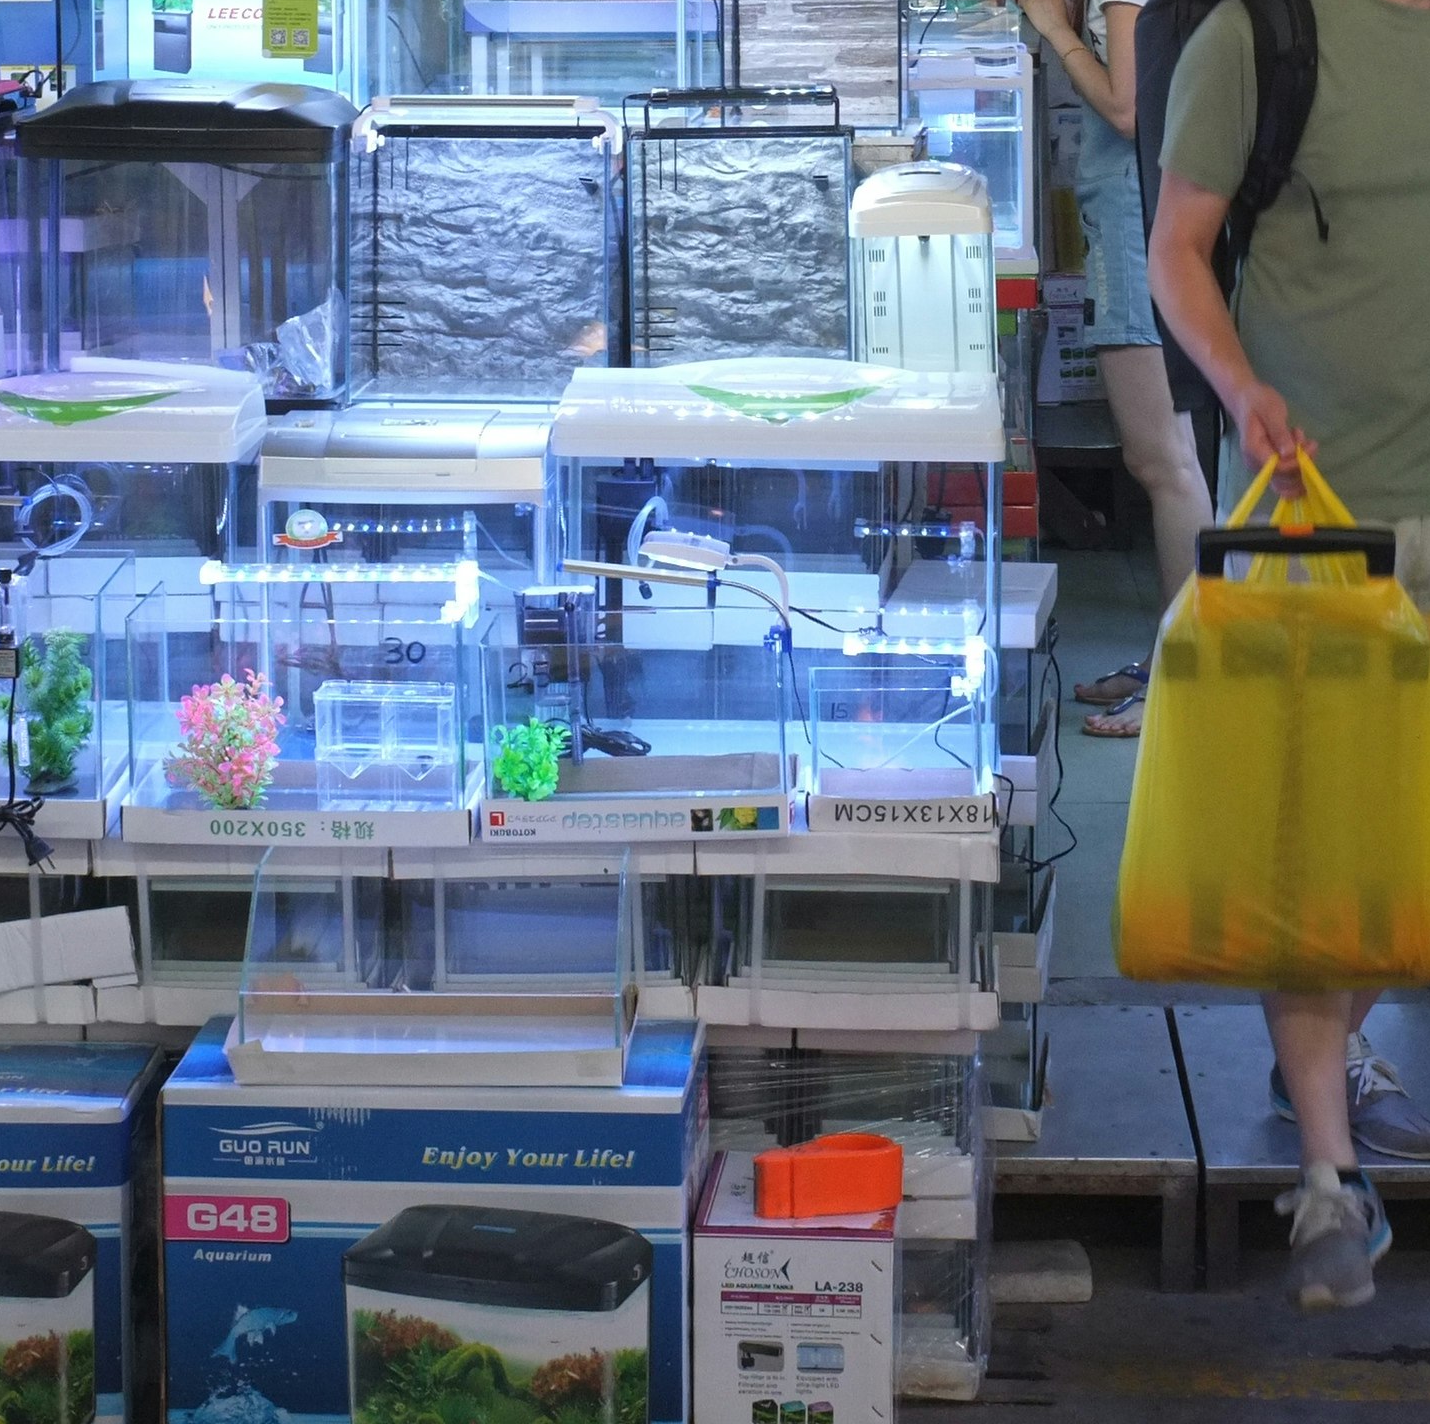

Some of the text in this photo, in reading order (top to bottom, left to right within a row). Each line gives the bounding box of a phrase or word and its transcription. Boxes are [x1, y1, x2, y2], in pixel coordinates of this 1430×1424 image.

[208, 8, 263, 19] LEECO
[385, 637, 426, 664] 30
[506, 662, 549, 689] 25
[832, 702, 849, 720] 15
[561, 811, 686, 833] aquastep
[834, 803, 992, 823] 18X13X15CM
[489, 828, 536, 837] KOTOBUKI
[219, 1139, 310, 1154] GUO RUN
[41, 1154, 96, 1172] Life!
[422, 1145, 635, 1170] Enjoy Your Life!
[187, 1203, 278, 1233] G48
[193, 1248, 272, 1262] Aquarium
[736, 1283, 771, 1291] AQUARIUM
[814, 1281, 864, 1293] LA-238
